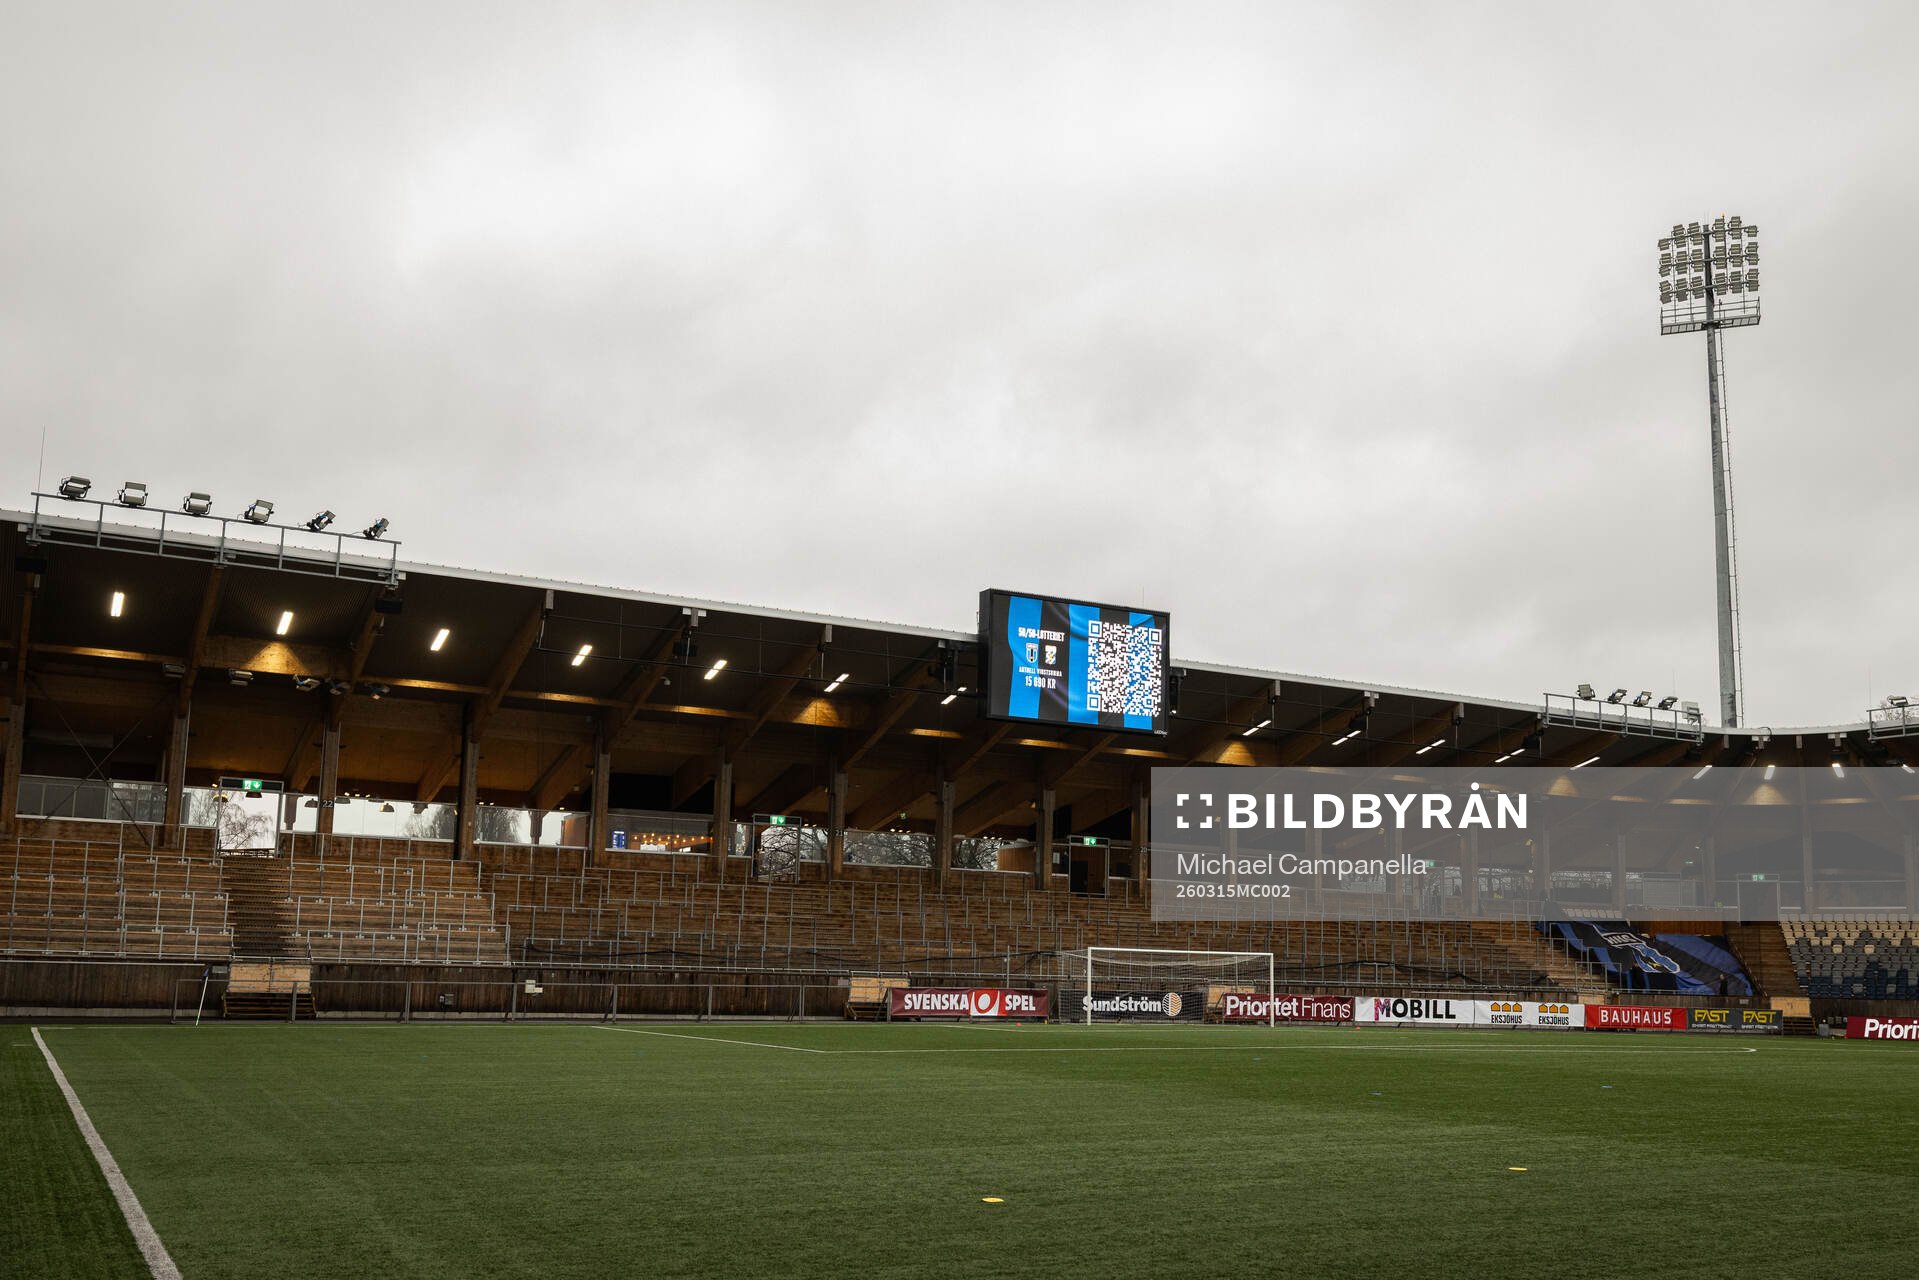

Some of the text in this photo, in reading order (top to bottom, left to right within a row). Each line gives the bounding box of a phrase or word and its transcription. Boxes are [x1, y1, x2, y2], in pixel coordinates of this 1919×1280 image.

[1025, 675, 1033, 687] 15
[1047, 678, 1056, 689] KR
[322, 799, 334, 808] 22
[904, 993, 1036, 1011] SVENSKA SPEL
[1082, 995, 1162, 1012] Sundström
[1226, 995, 1351, 1018] Priortet Finans
[1374, 998, 1456, 1021] MOBILL
[1600, 1009, 1672, 1025] BAUHAUS
[1695, 1009, 1730, 1023] FAST
[1743, 1011, 1777, 1023] FAST
[1864, 1018, 1919, 1039] Priori
